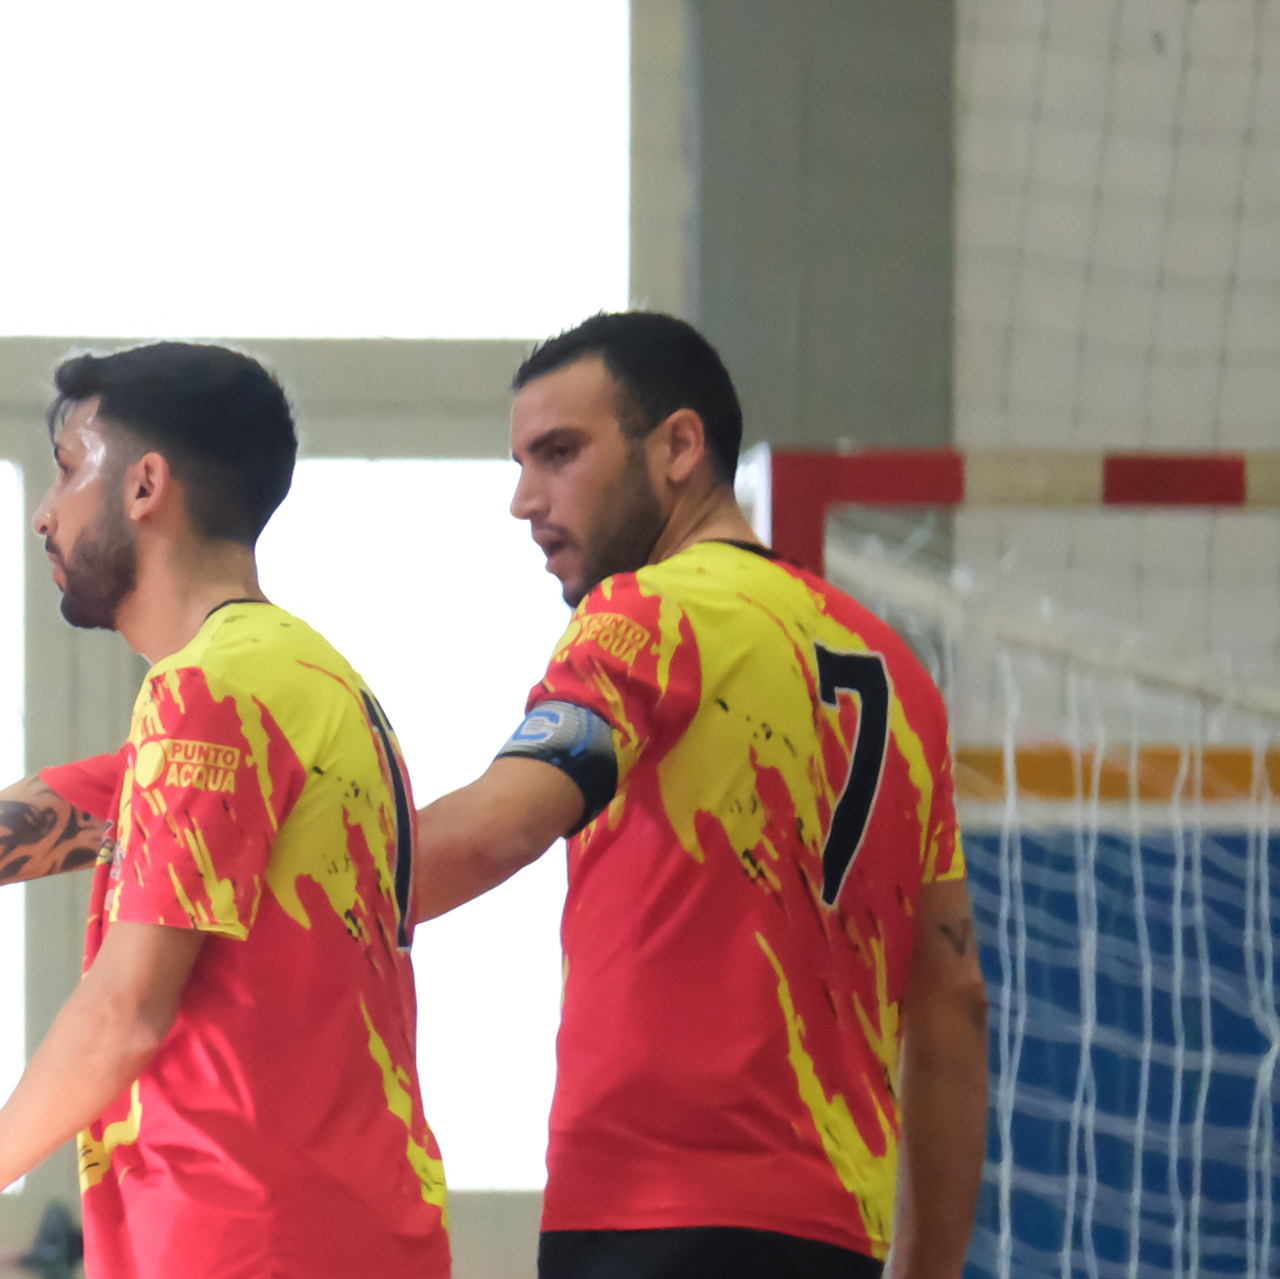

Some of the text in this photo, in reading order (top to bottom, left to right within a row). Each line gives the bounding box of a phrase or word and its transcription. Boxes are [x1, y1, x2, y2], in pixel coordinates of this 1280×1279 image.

[171, 741, 237, 767] PUNTO
[164, 762, 236, 795] ACQUA
[813, 641, 890, 907] 7
